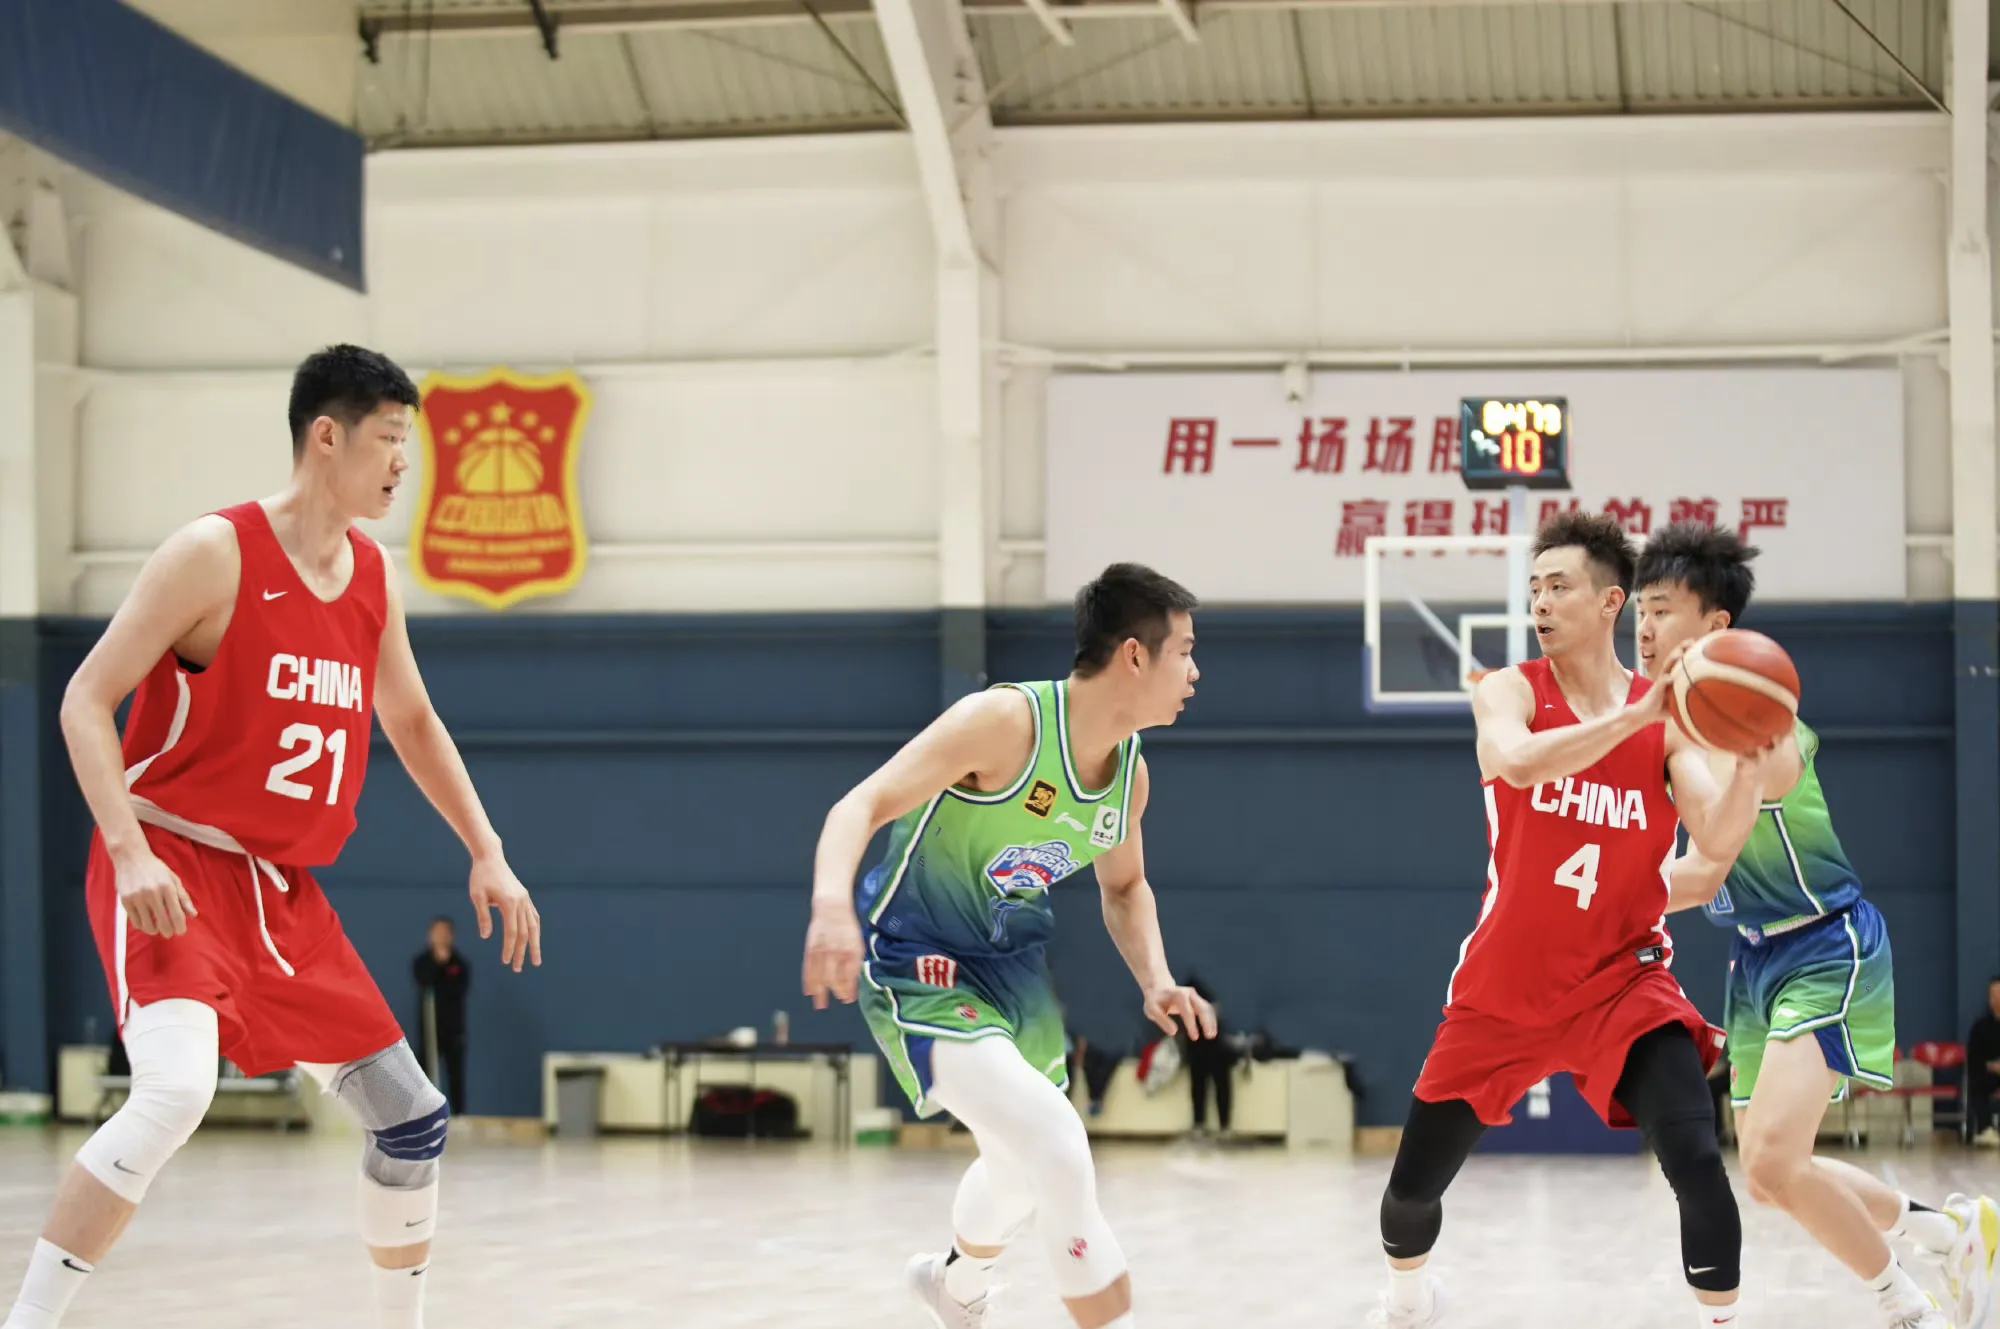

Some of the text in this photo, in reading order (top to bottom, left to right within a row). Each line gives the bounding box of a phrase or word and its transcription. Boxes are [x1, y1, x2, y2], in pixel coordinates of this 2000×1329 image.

[1501, 430, 1541, 475] 10
[266, 652, 363, 713] CHINA
[265, 721, 347, 806] 21
[1531, 776, 1648, 830] CHINA
[1553, 843, 1601, 911] 4
